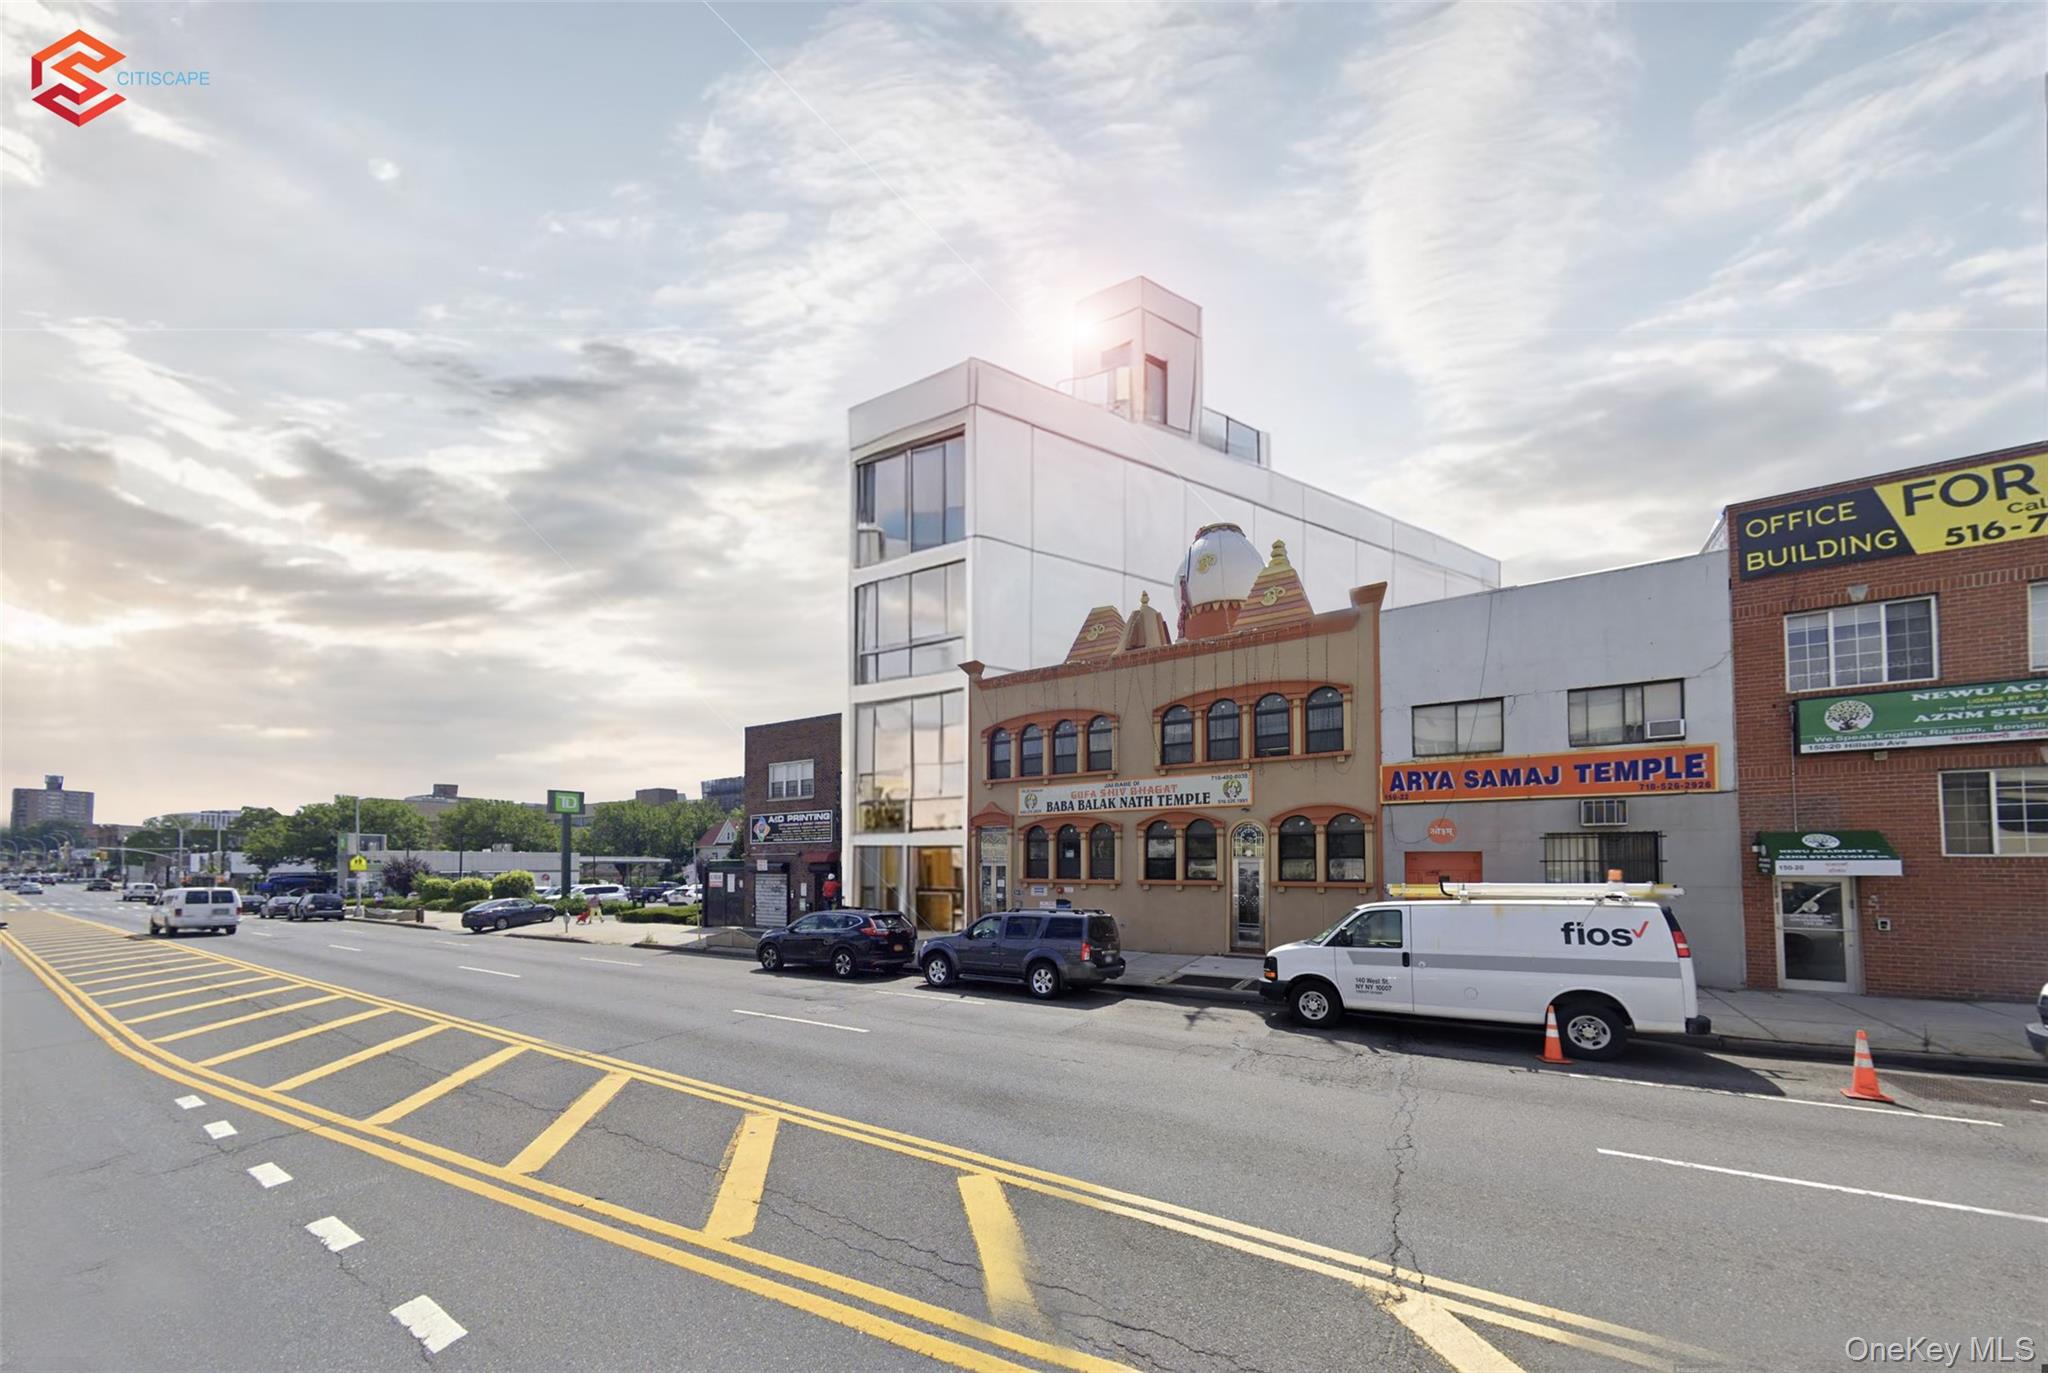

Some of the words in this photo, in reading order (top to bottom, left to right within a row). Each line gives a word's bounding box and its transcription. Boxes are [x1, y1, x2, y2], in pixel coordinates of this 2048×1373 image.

[1902, 463, 2040, 517] FOR
[1745, 501, 1857, 538] OFFICE
[1746, 529, 1898, 572] BUILDING
[1911, 687, 1995, 702] NEWU
[2002, 683, 2048, 695] AC
[1914, 710, 1985, 723] AZNM
[1807, 743, 1842, 751] 150-20
[1835, 734, 1873, 742] Speak
[1389, 770, 1456, 792] ARYA
[1463, 765, 1562, 790] SAMAJ
[1573, 752, 1708, 784] TEMPLE
[1099, 787, 1127, 798] SHIV
[1129, 784, 1178, 796] BHAGAT
[559, 795, 577, 809] TD
[1046, 800, 1075, 813] BABA
[1077, 797, 1117, 811] BALAK
[1119, 794, 1153, 809] NATH
[1156, 791, 1211, 807] TEMPLE
[787, 812, 830, 822] PRINTING
[1560, 921, 1633, 947] fios
